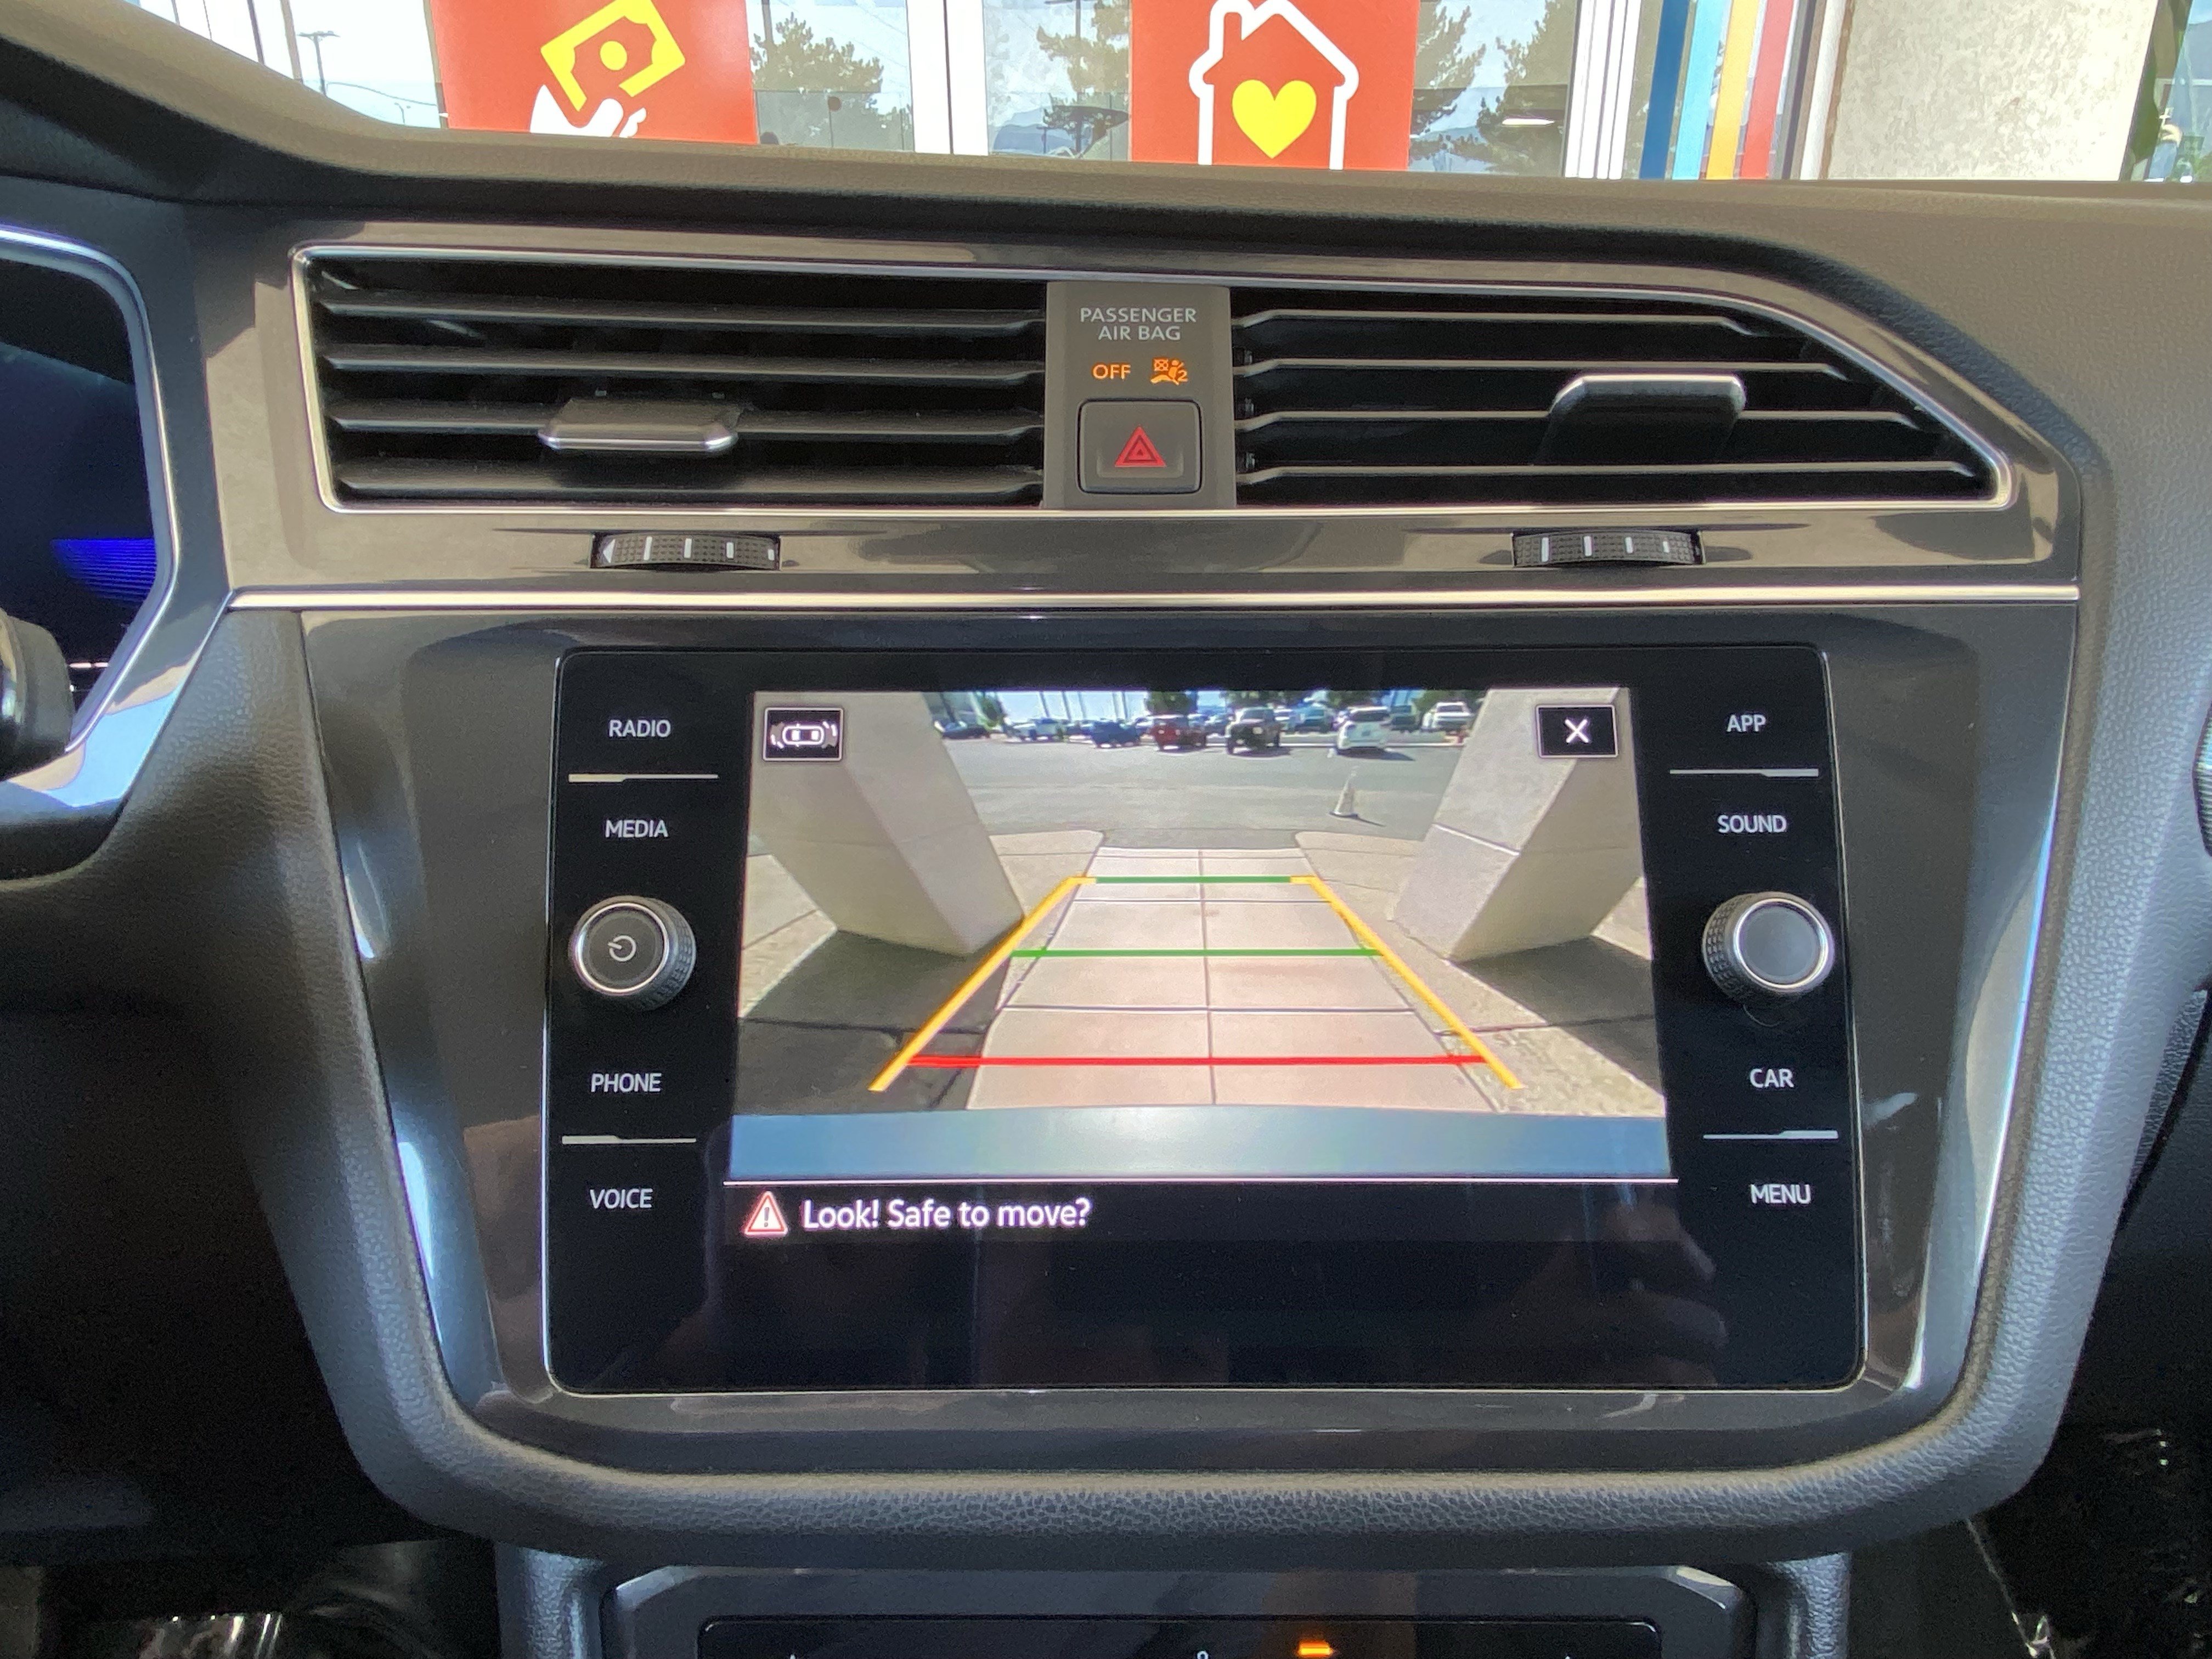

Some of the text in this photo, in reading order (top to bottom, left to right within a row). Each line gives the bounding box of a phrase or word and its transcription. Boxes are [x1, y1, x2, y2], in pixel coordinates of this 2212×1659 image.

[1080, 307, 1197, 323] PASSENGER
[1098, 325, 1181, 341] AIR BAG
[1093, 364, 1131, 380] OFF
[609, 719, 671, 737] RADIO
[1726, 714, 1766, 732] APP
[605, 819, 668, 838] MEDIA
[1718, 815, 1787, 833] SOUND
[591, 1073, 662, 1093] PHONE
[1750, 1068, 1795, 1088] CAR
[590, 1188, 653, 1209] VOICE
[1750, 1183, 1812, 1204] MENU
[803, 1197, 1091, 1229] Look! Safe to move?
